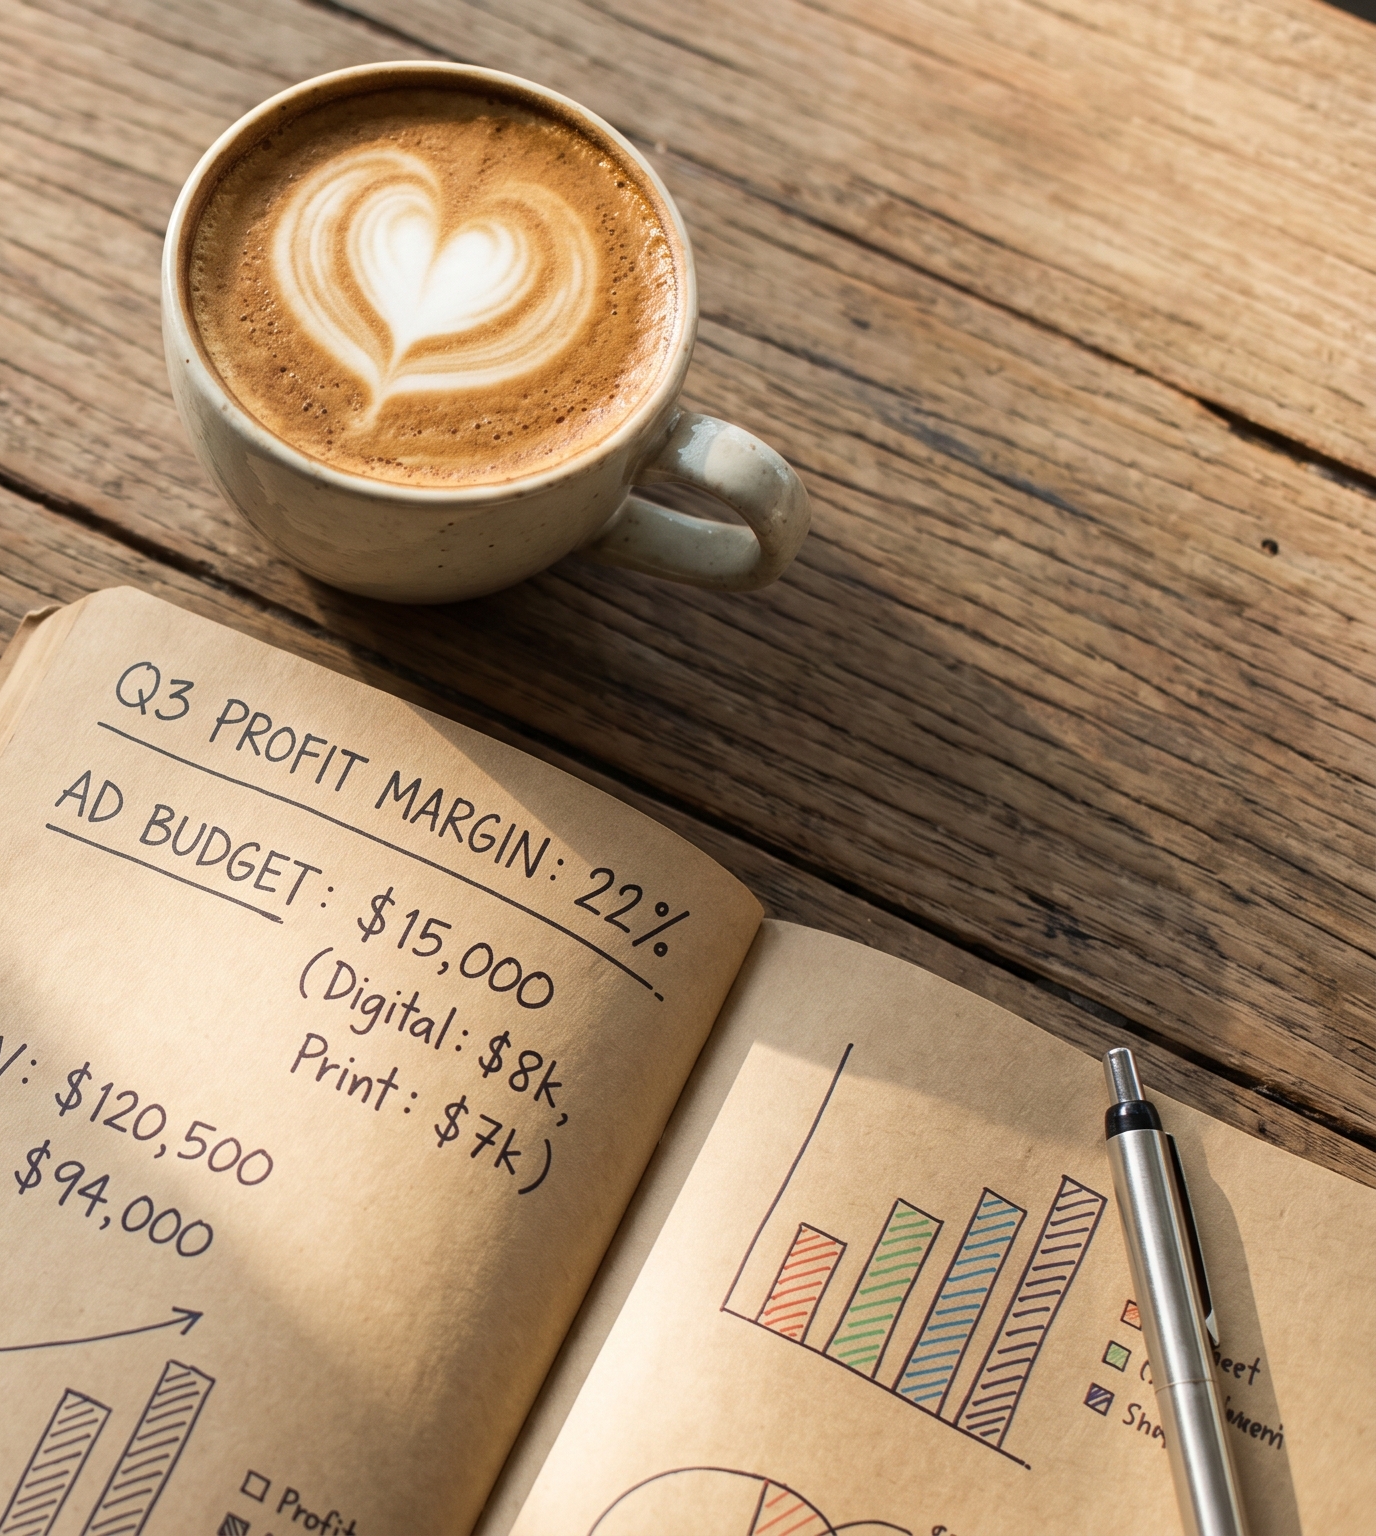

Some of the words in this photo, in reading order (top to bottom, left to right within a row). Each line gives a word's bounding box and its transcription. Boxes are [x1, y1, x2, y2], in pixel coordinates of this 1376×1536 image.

[116, 660, 194, 721] Q3
[208, 699, 370, 792] PROFIT
[374, 769, 565, 881] MARGIN:
[573, 867, 691, 958] 22%
[54, 769, 124, 823] AD
[139, 803, 334, 908] BUDGET:
[357, 886, 555, 1009] $15,000
[299, 946, 470, 1051] (Digital:
[54, 1061, 274, 1187] $120,500
[290, 1032, 419, 1113] Print:
[14, 1139, 215, 1258] $94,000
